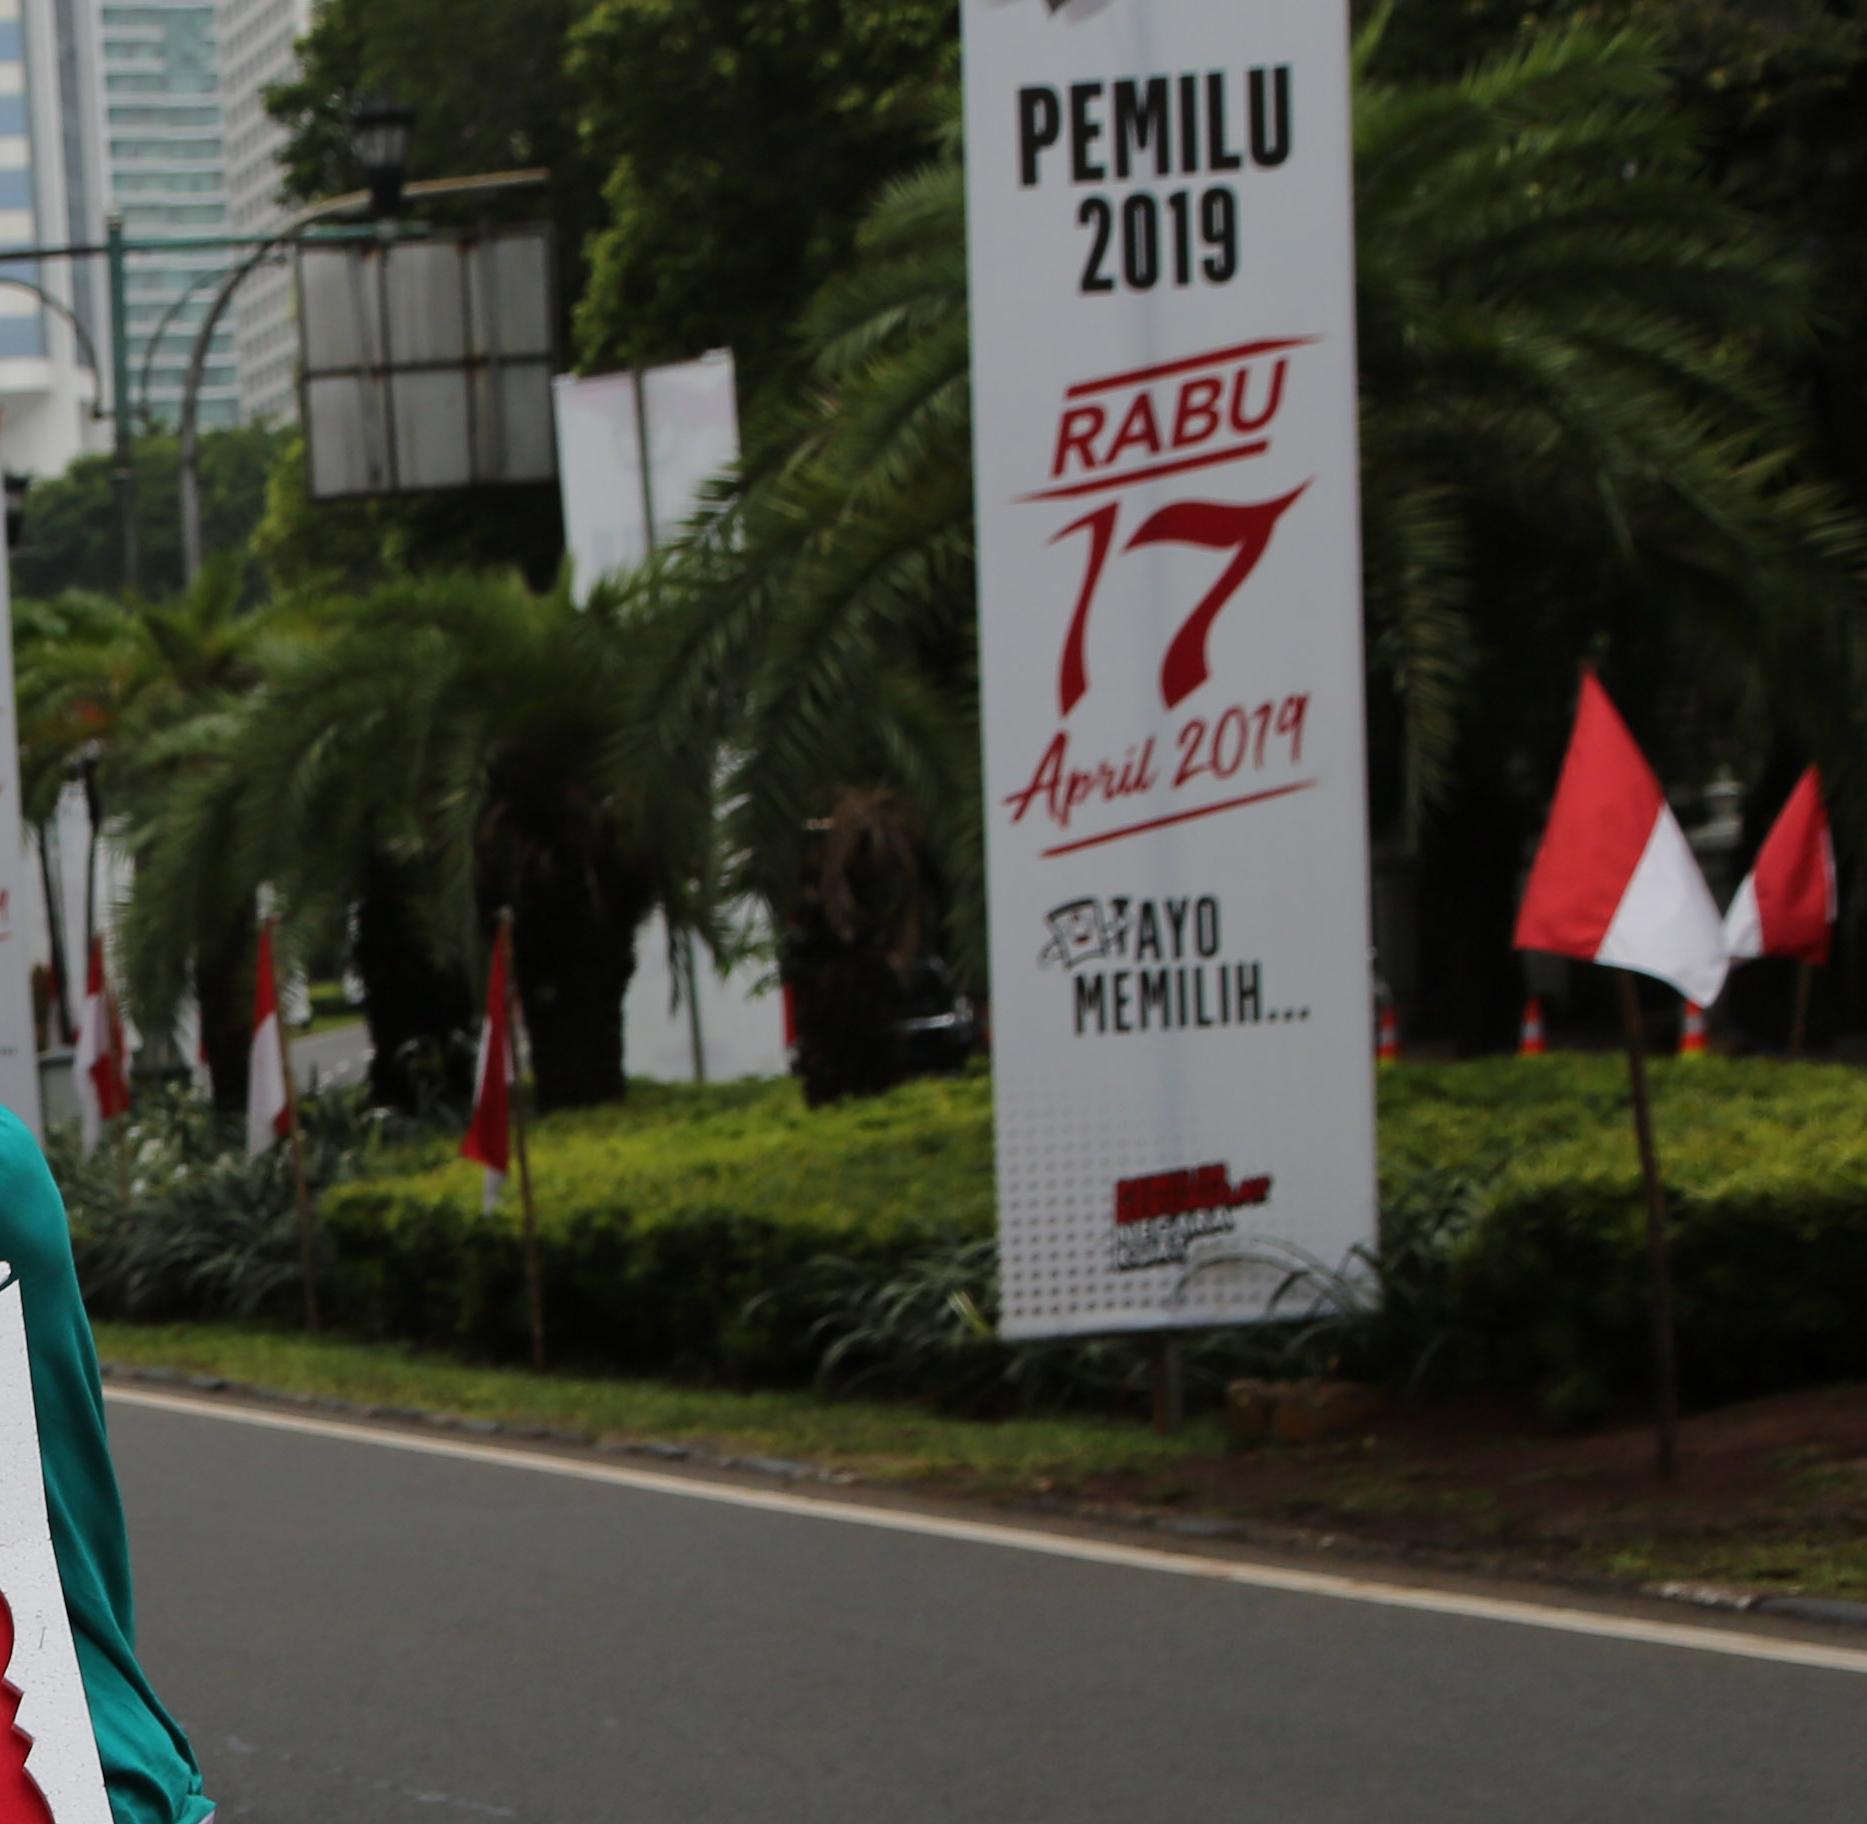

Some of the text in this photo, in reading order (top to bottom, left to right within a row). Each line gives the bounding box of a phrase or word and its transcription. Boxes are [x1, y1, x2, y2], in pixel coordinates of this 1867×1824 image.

[1018, 65, 1292, 187] PEMILU
[1077, 186, 1238, 293] 2019
[1050, 358, 1288, 478] RABU
[1046, 477, 1316, 717] 17
[1001, 692, 1309, 828] April 2019
[1074, 962, 1309, 1035] MEMILIH...
